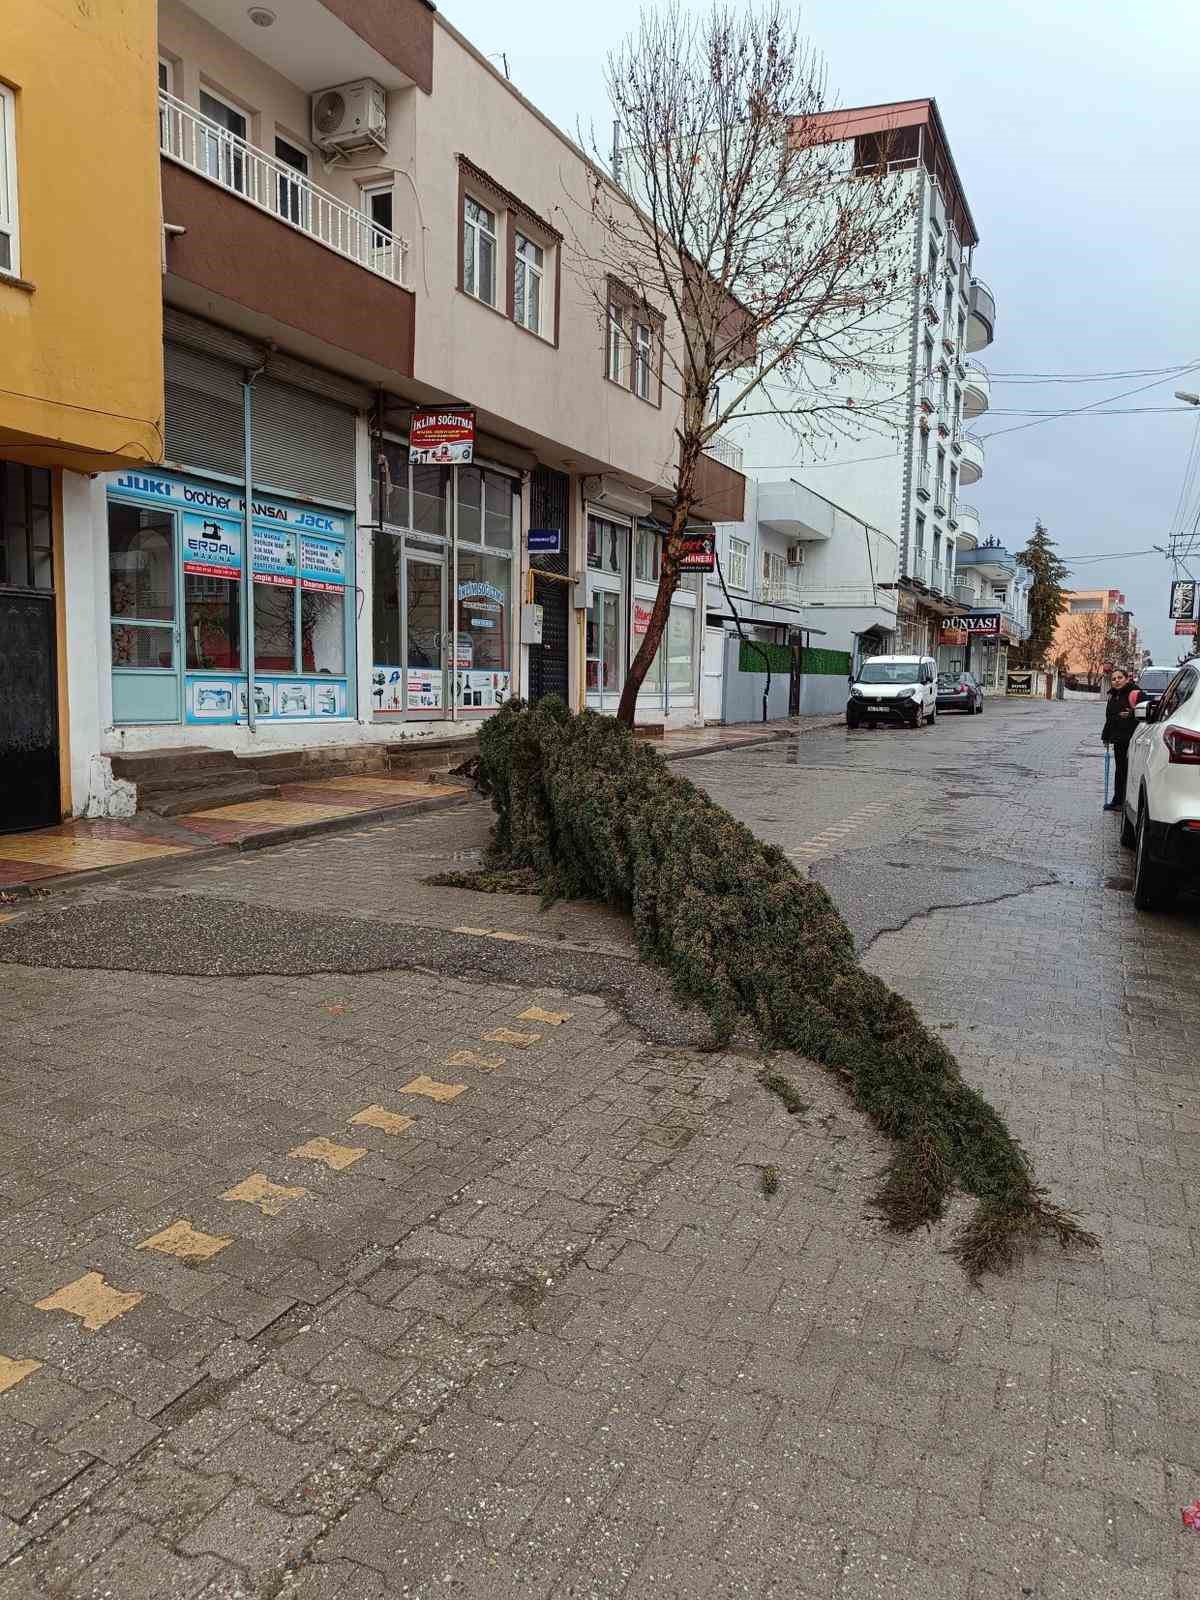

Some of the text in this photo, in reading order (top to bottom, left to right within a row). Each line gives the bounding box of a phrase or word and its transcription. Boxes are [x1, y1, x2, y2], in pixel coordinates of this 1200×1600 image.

[437, 413, 473, 430] SOĞUTMA
[118, 476, 171, 495] JUKI
[183, 486, 231, 510] brother
[187, 538, 236, 556] ERDAL
[942, 616, 997, 630] DÜNYASI
